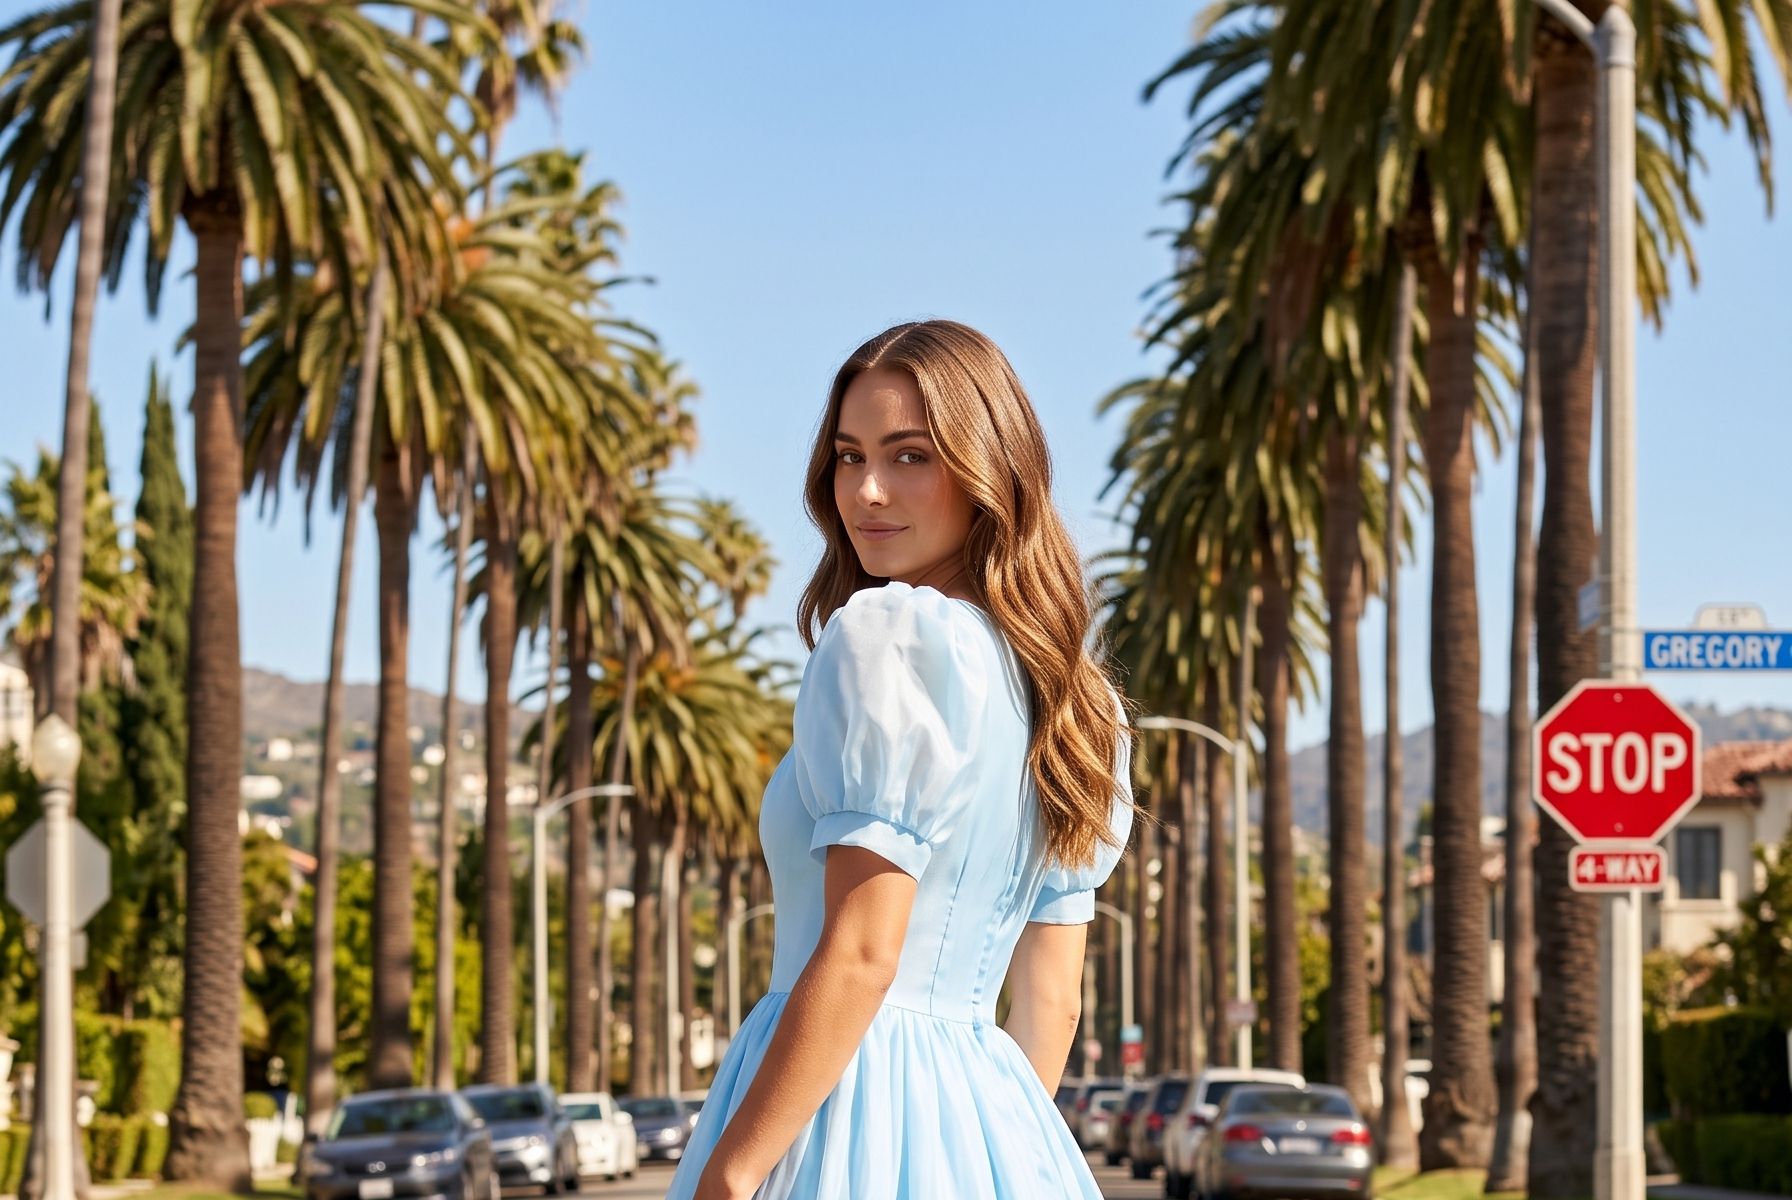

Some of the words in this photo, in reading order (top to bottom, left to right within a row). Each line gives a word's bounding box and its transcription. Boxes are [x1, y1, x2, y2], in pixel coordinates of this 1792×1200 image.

[1650, 634, 1782, 668] GREGORY
[1546, 731, 1688, 794] STOP
[1577, 855, 1660, 883] 4-WAY
